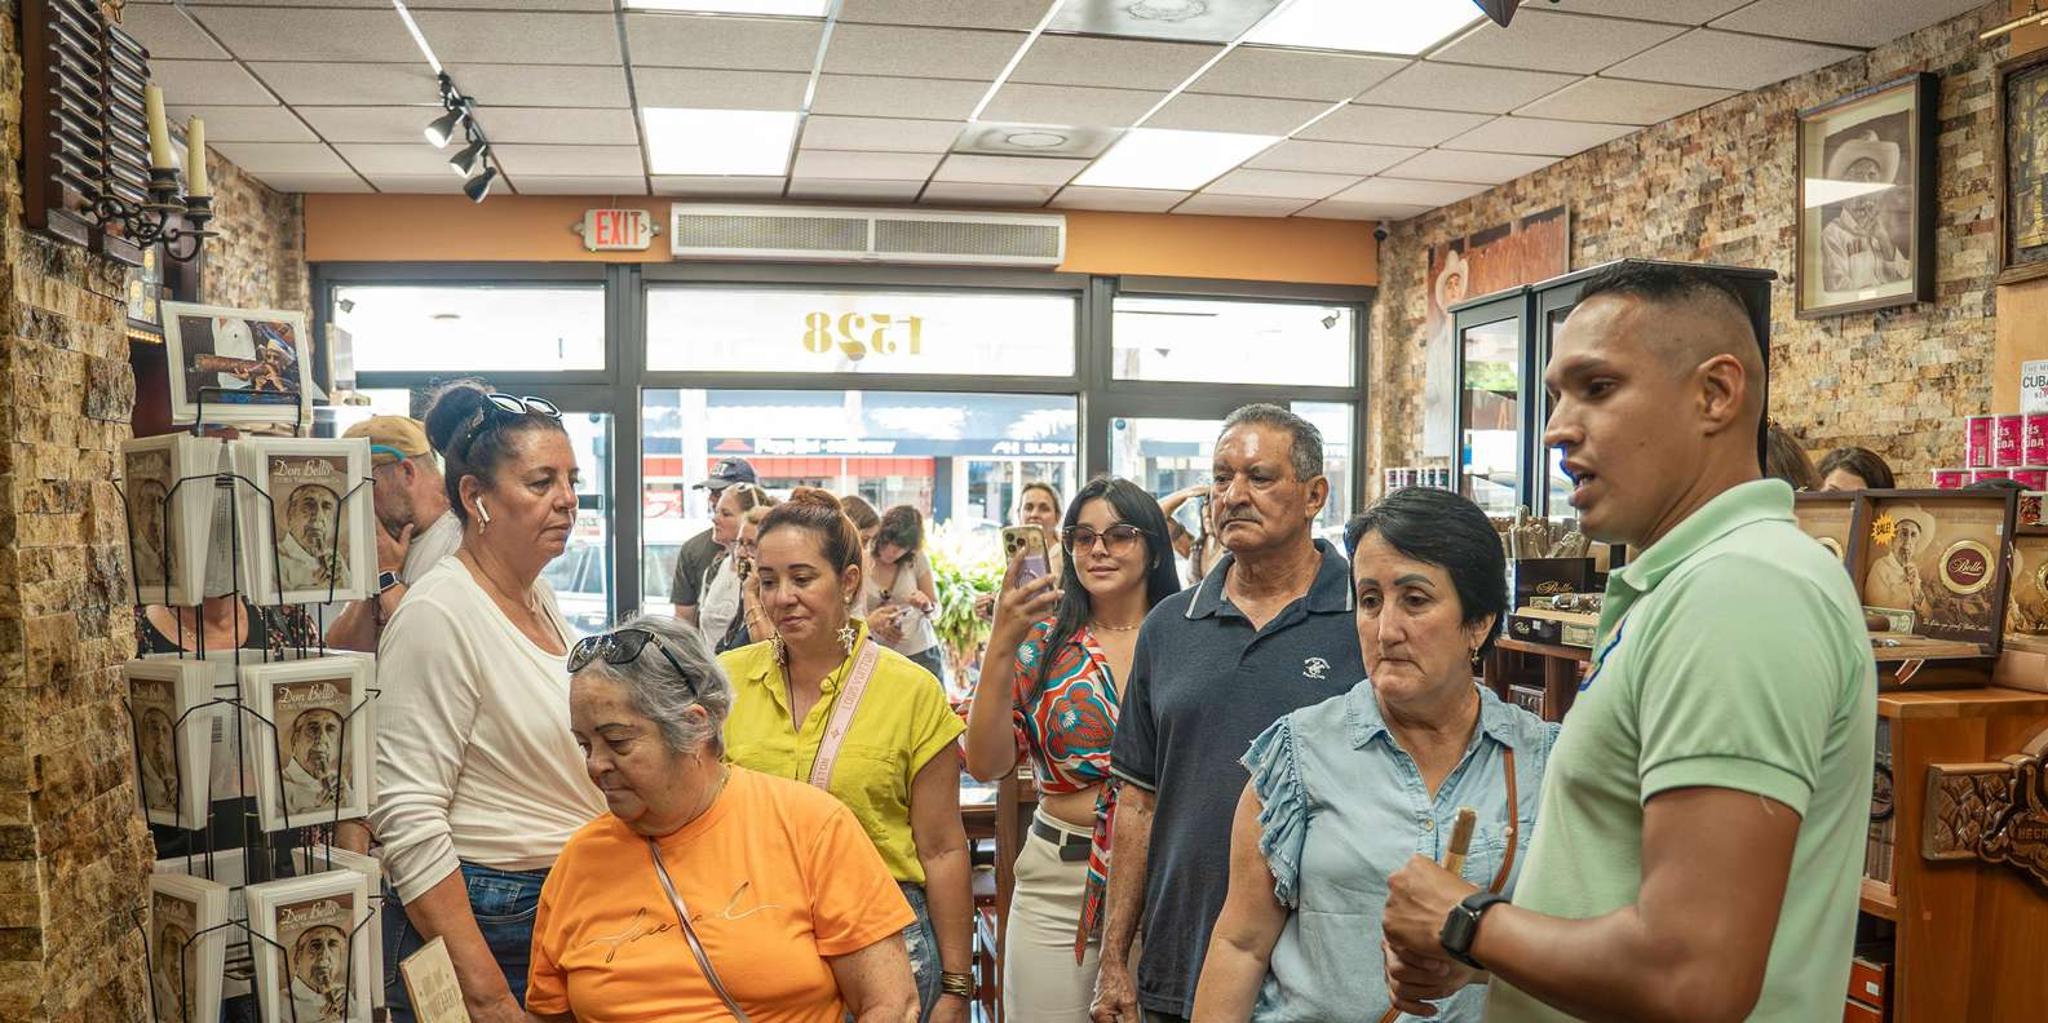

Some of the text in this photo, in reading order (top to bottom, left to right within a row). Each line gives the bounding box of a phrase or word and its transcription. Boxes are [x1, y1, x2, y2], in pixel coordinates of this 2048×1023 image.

[596, 211, 642, 245] EXIT
[272, 458, 331, 477] Don Bello
[278, 686, 306, 705] Don
[307, 682, 336, 702] Bello
[281, 908, 308, 925] Don
[309, 899, 338, 920] Bello
